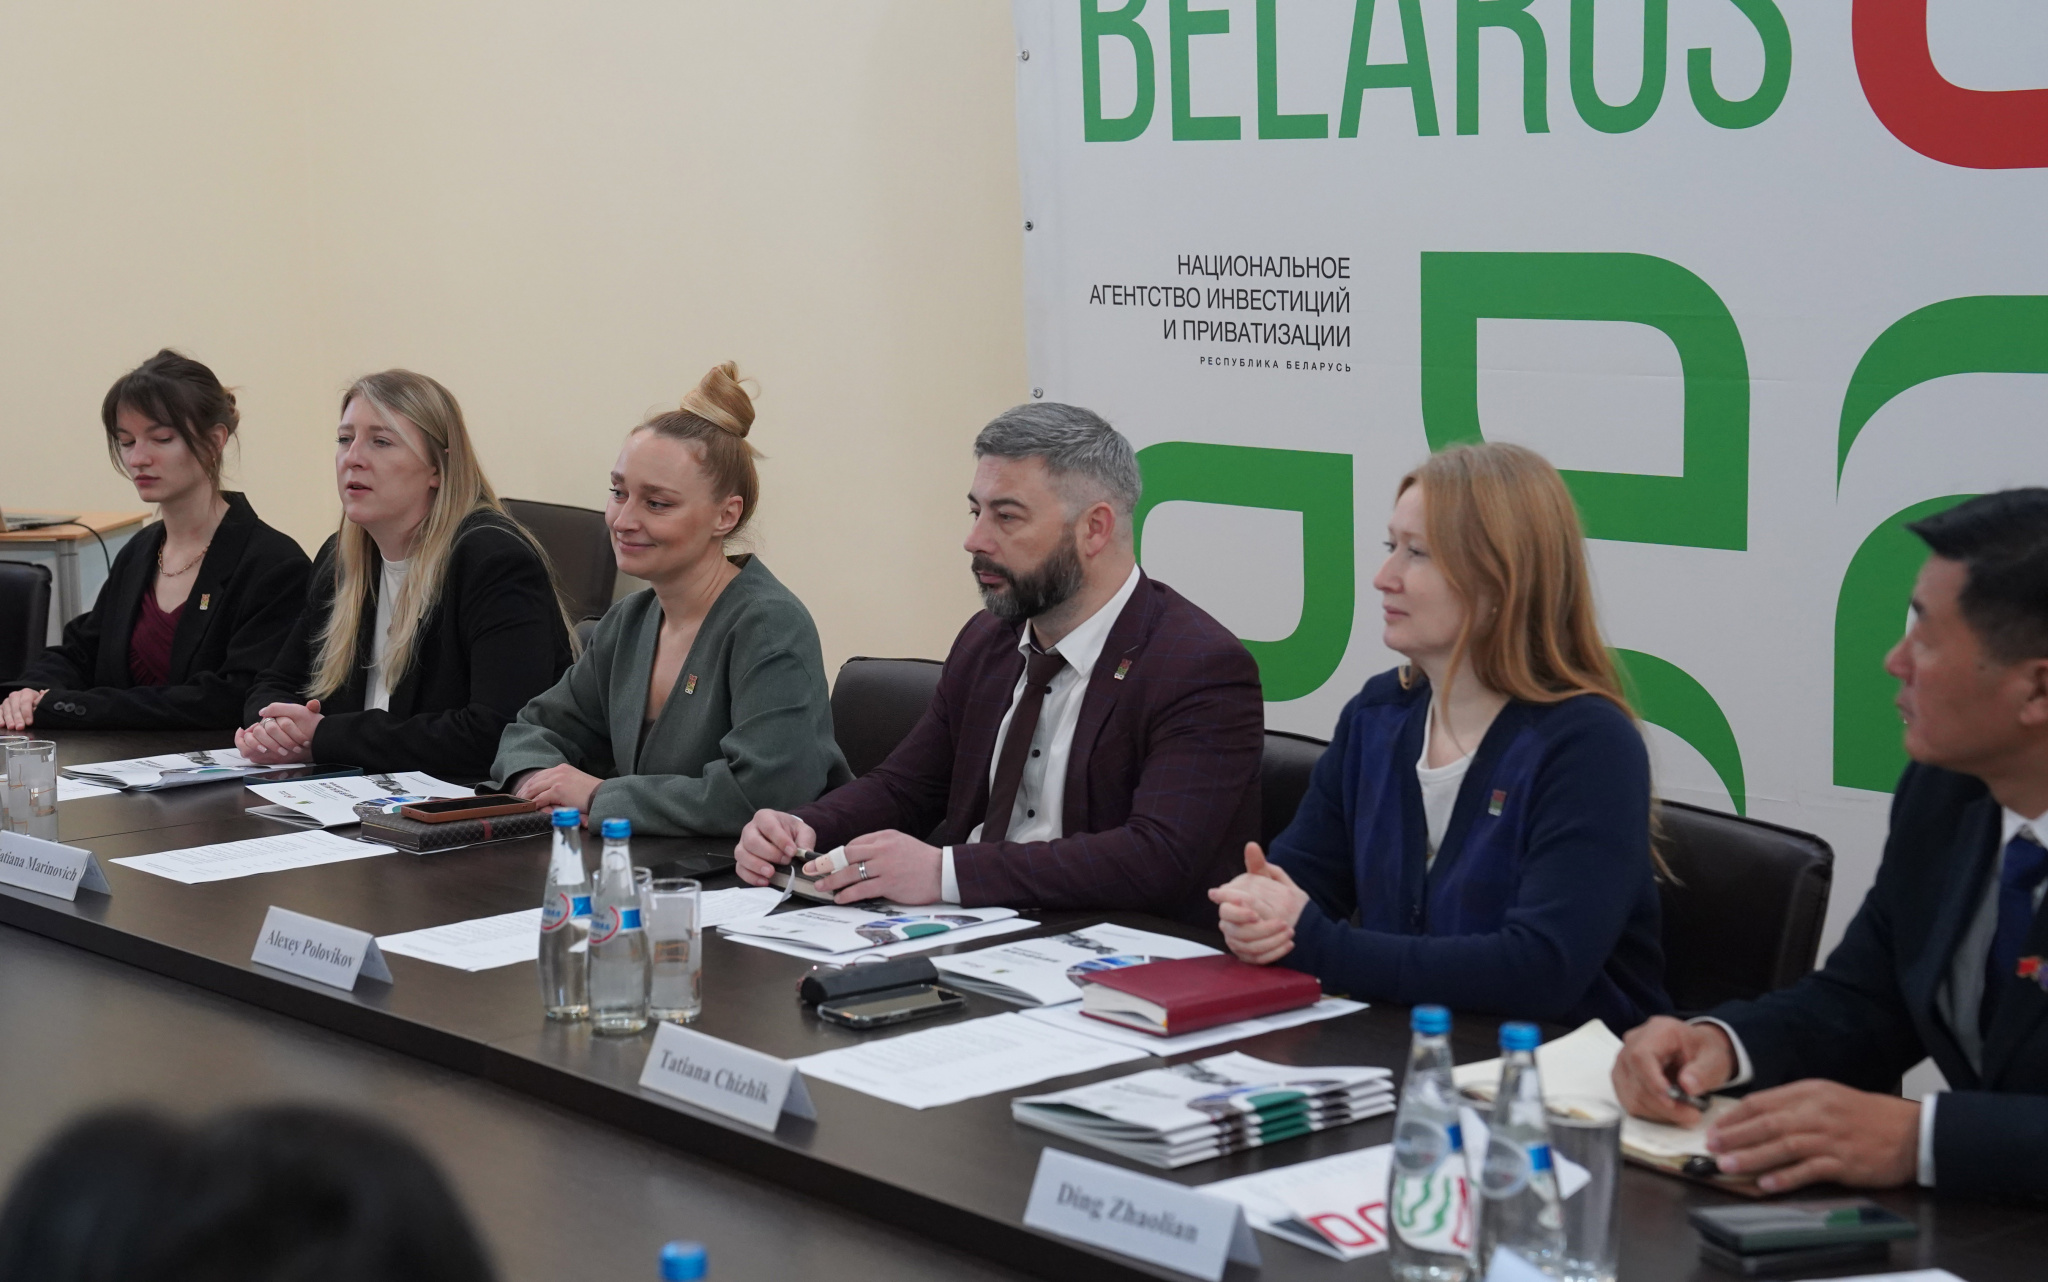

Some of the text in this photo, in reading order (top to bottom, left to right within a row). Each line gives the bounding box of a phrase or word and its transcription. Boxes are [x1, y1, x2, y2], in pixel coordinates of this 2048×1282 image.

[1079, 0, 1792, 143] BELARUS
[1177, 254, 1351, 281] НАЦИОНАЛЬНОЕ
[1089, 284, 1351, 317] АГЕНТСТВО ИНВЕСТИЦИЙ
[1163, 318, 1351, 351] И ПРИВАТИЗАЦИИ
[1200, 356, 1352, 373] РЕСПУБЛИКА БЕЛАРУСЬ
[26, 855, 78, 882] Marinovich
[265, 929, 356, 969] Alexey Polovikov
[660, 1049, 772, 1105] Tatiana Chizhik
[1056, 1181, 1199, 1244] Ding Zhaolian
